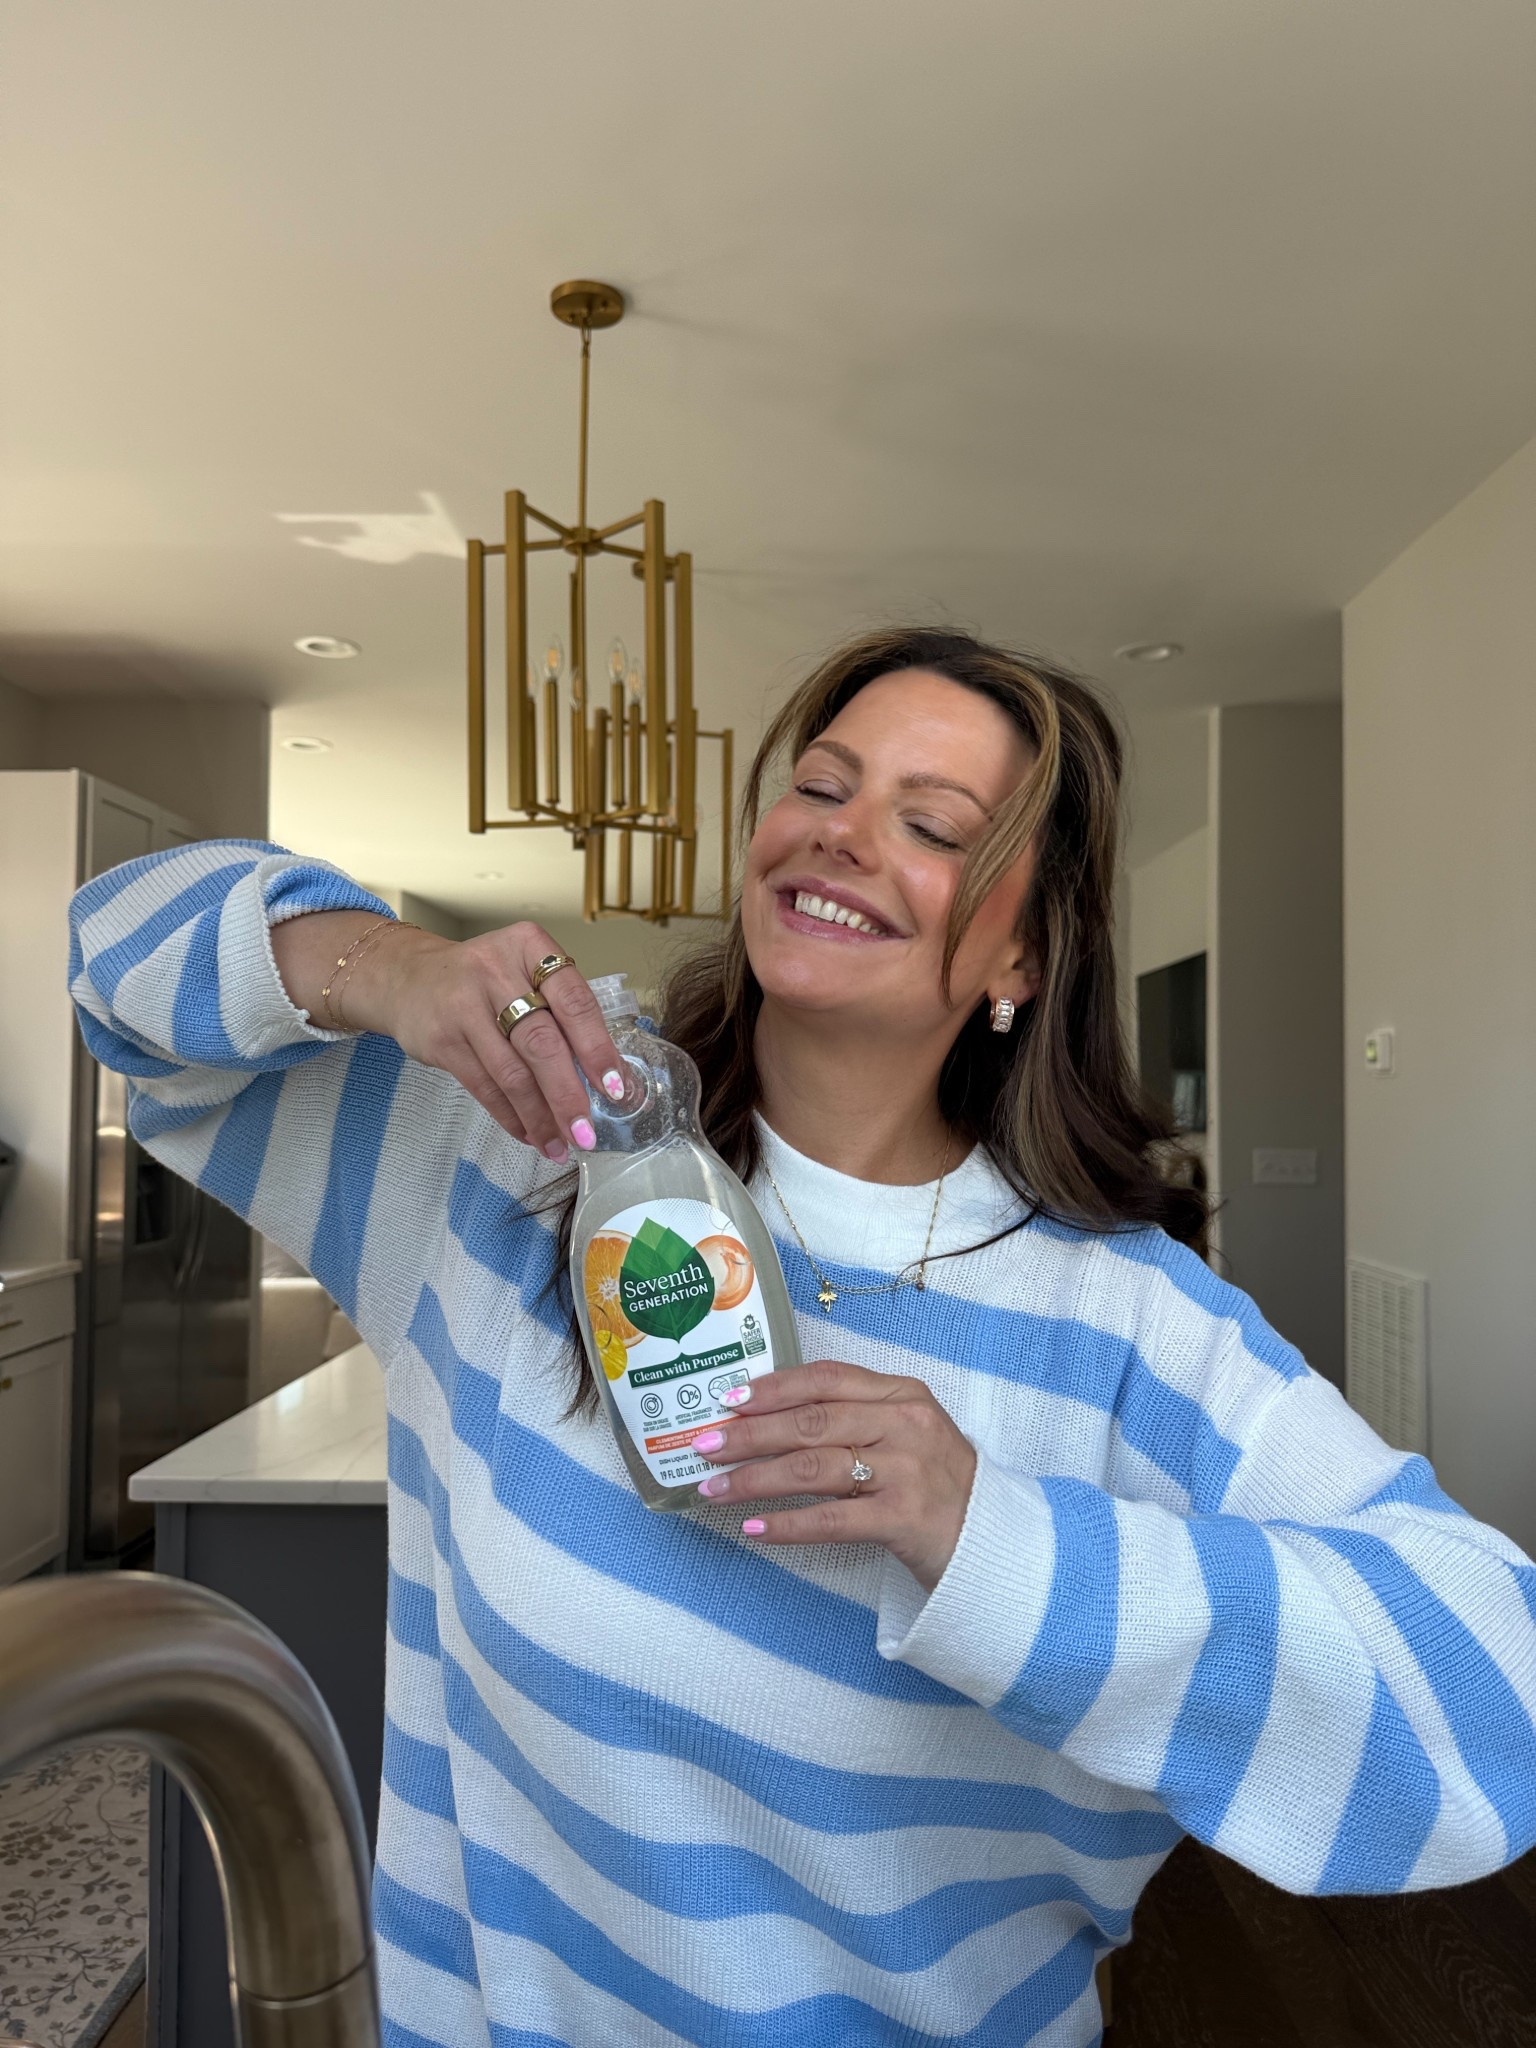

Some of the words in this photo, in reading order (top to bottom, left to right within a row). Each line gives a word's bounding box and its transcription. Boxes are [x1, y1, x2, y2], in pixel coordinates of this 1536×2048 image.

[623, 1263, 705, 1299] Seventh
[628, 1283, 709, 1313] GENERATION
[743, 1328, 761, 1338] SAFER
[633, 1370, 664, 1383] Clean
[665, 1361, 691, 1375] with
[692, 1348, 739, 1369] Purpose
[680, 1390, 698, 1404] 0%
[659, 1457, 671, 1465] DISH
[660, 1471, 667, 1480] 19
[667, 1469, 676, 1479] FL
[676, 1467, 685, 1477] OZ
[685, 1465, 695, 1476] LIQ
[696, 1462, 710, 1473] (1.18
